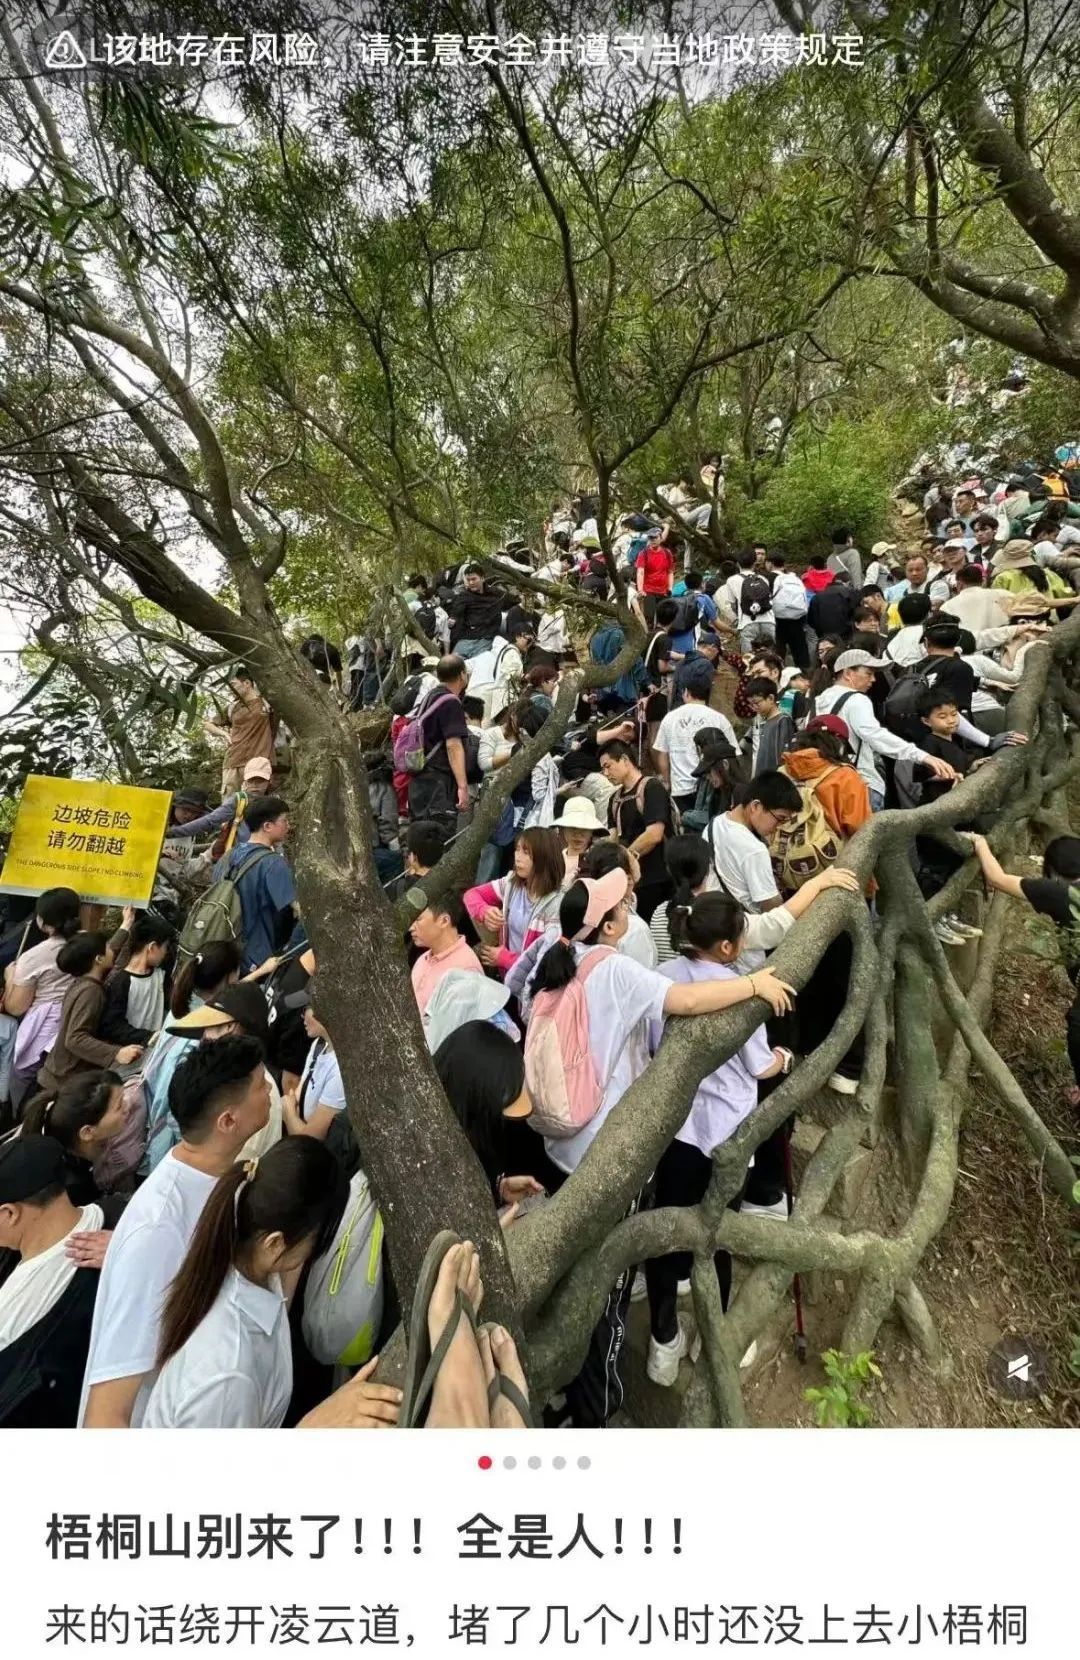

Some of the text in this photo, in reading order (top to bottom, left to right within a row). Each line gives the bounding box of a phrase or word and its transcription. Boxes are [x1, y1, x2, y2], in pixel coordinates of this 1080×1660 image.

[52, 804, 132, 830] 边坡危险
[48, 830, 126, 855] 请勿翻越
